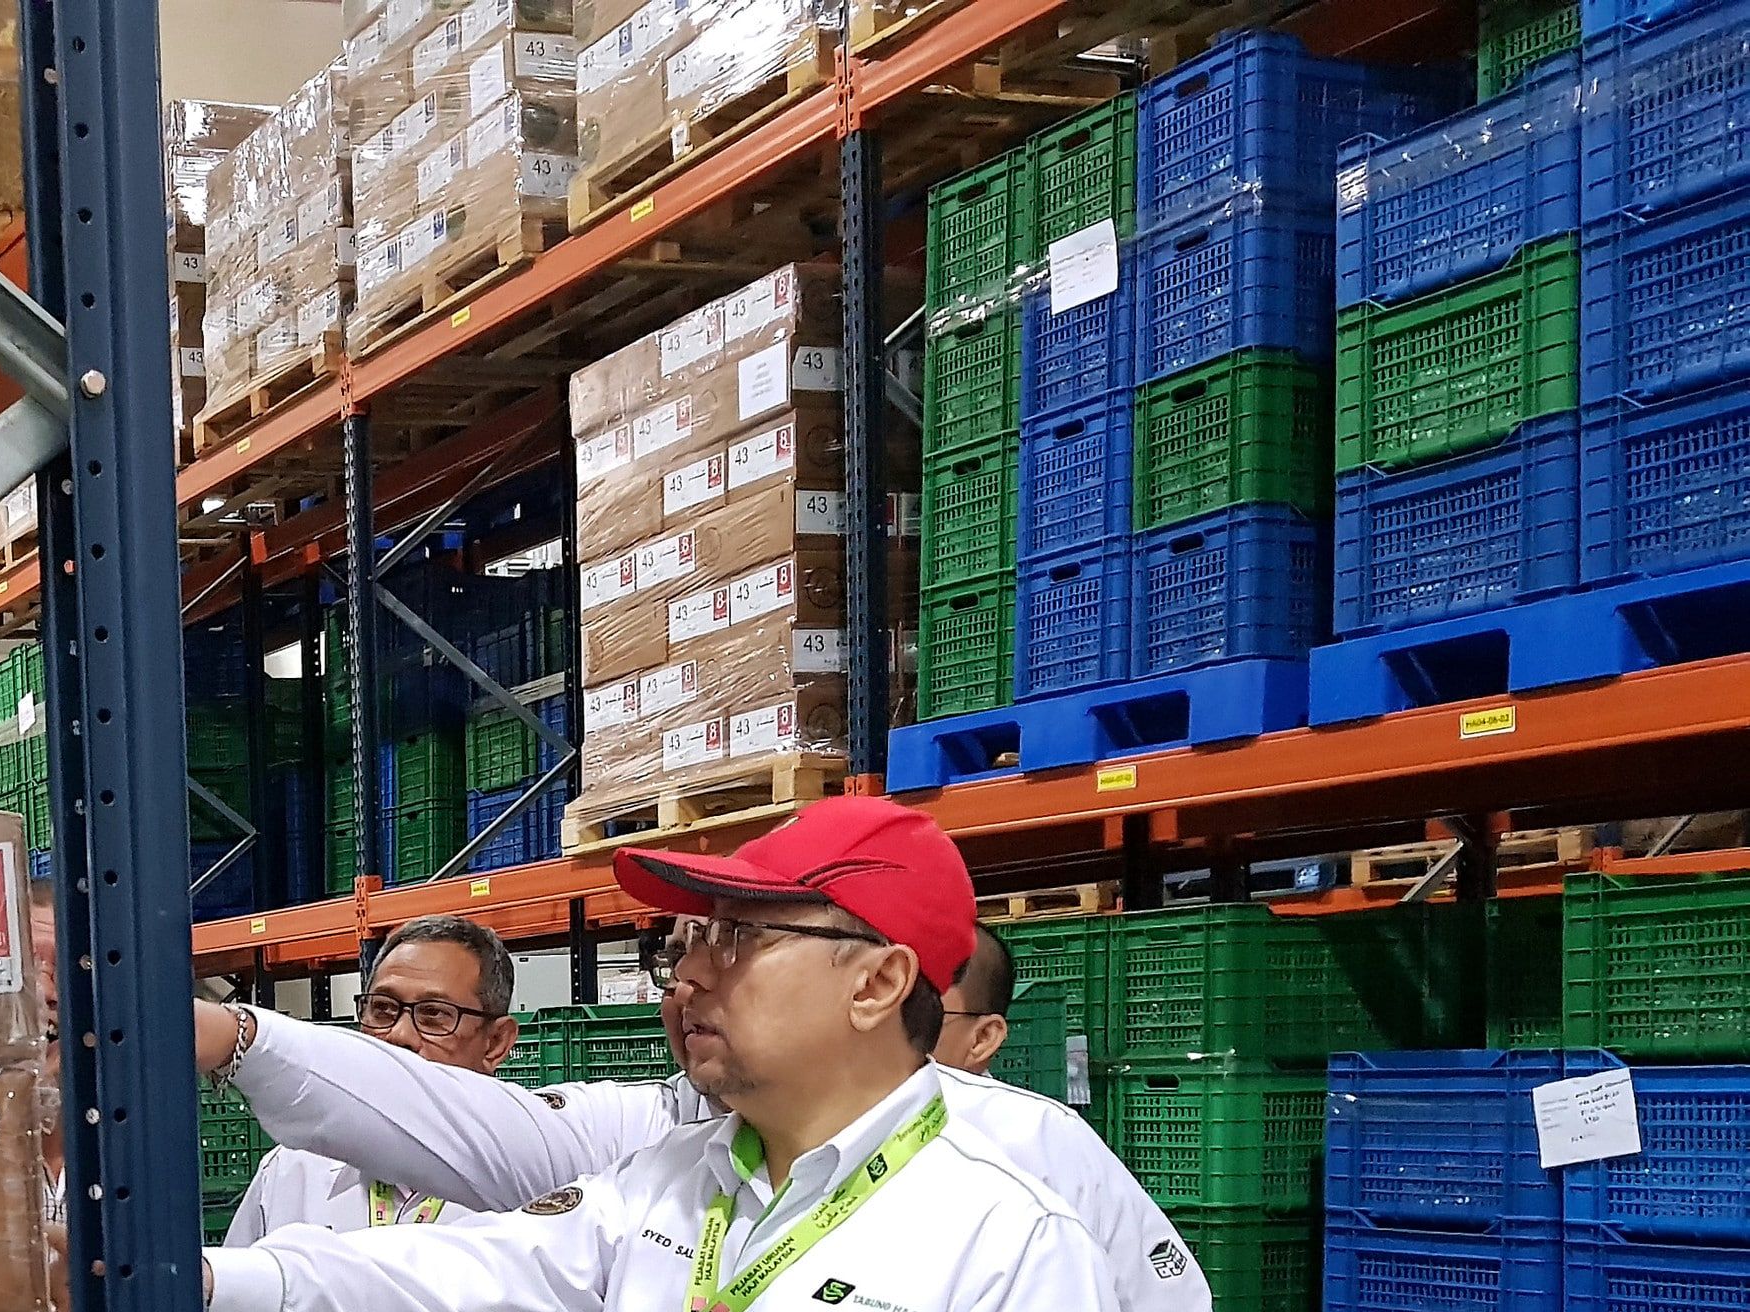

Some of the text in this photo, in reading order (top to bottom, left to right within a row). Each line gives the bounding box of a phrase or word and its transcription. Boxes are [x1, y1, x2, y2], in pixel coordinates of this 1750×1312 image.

[525, 41, 545, 57] 43
[532, 160, 551, 175] 43
[183, 257, 199, 269] 43
[778, 277, 787, 295] 8
[732, 299, 746, 317] 43
[802, 351, 824, 370] 43
[779, 429, 788, 448] 8
[734, 447, 748, 465] 43
[711, 460, 718, 476] 8
[670, 475, 683, 492] 43
[806, 496, 828, 514] 43
[681, 536, 689, 553] 8
[623, 559, 630, 575] 8
[642, 552, 654, 568] 43
[586, 573, 597, 589] 43
[781, 566, 788, 584] 8
[717, 590, 724, 607] 8
[736, 583, 749, 600] 43
[676, 605, 688, 621] 43
[803, 635, 825, 652] 43
[685, 666, 692, 681] 8
[626, 686, 633, 700] 8
[781, 707, 789, 725] 8
[709, 723, 717, 738] 8
[736, 719, 749, 736] 43
[668, 735, 680, 751] 43
[642, 1229, 672, 1248] SYED
[730, 1236, 794, 1296] PEJABAT URUSAN
[742, 1248, 796, 1297] HAJI MALAYSIA
[853, 1294, 891, 1311] TABUNG
